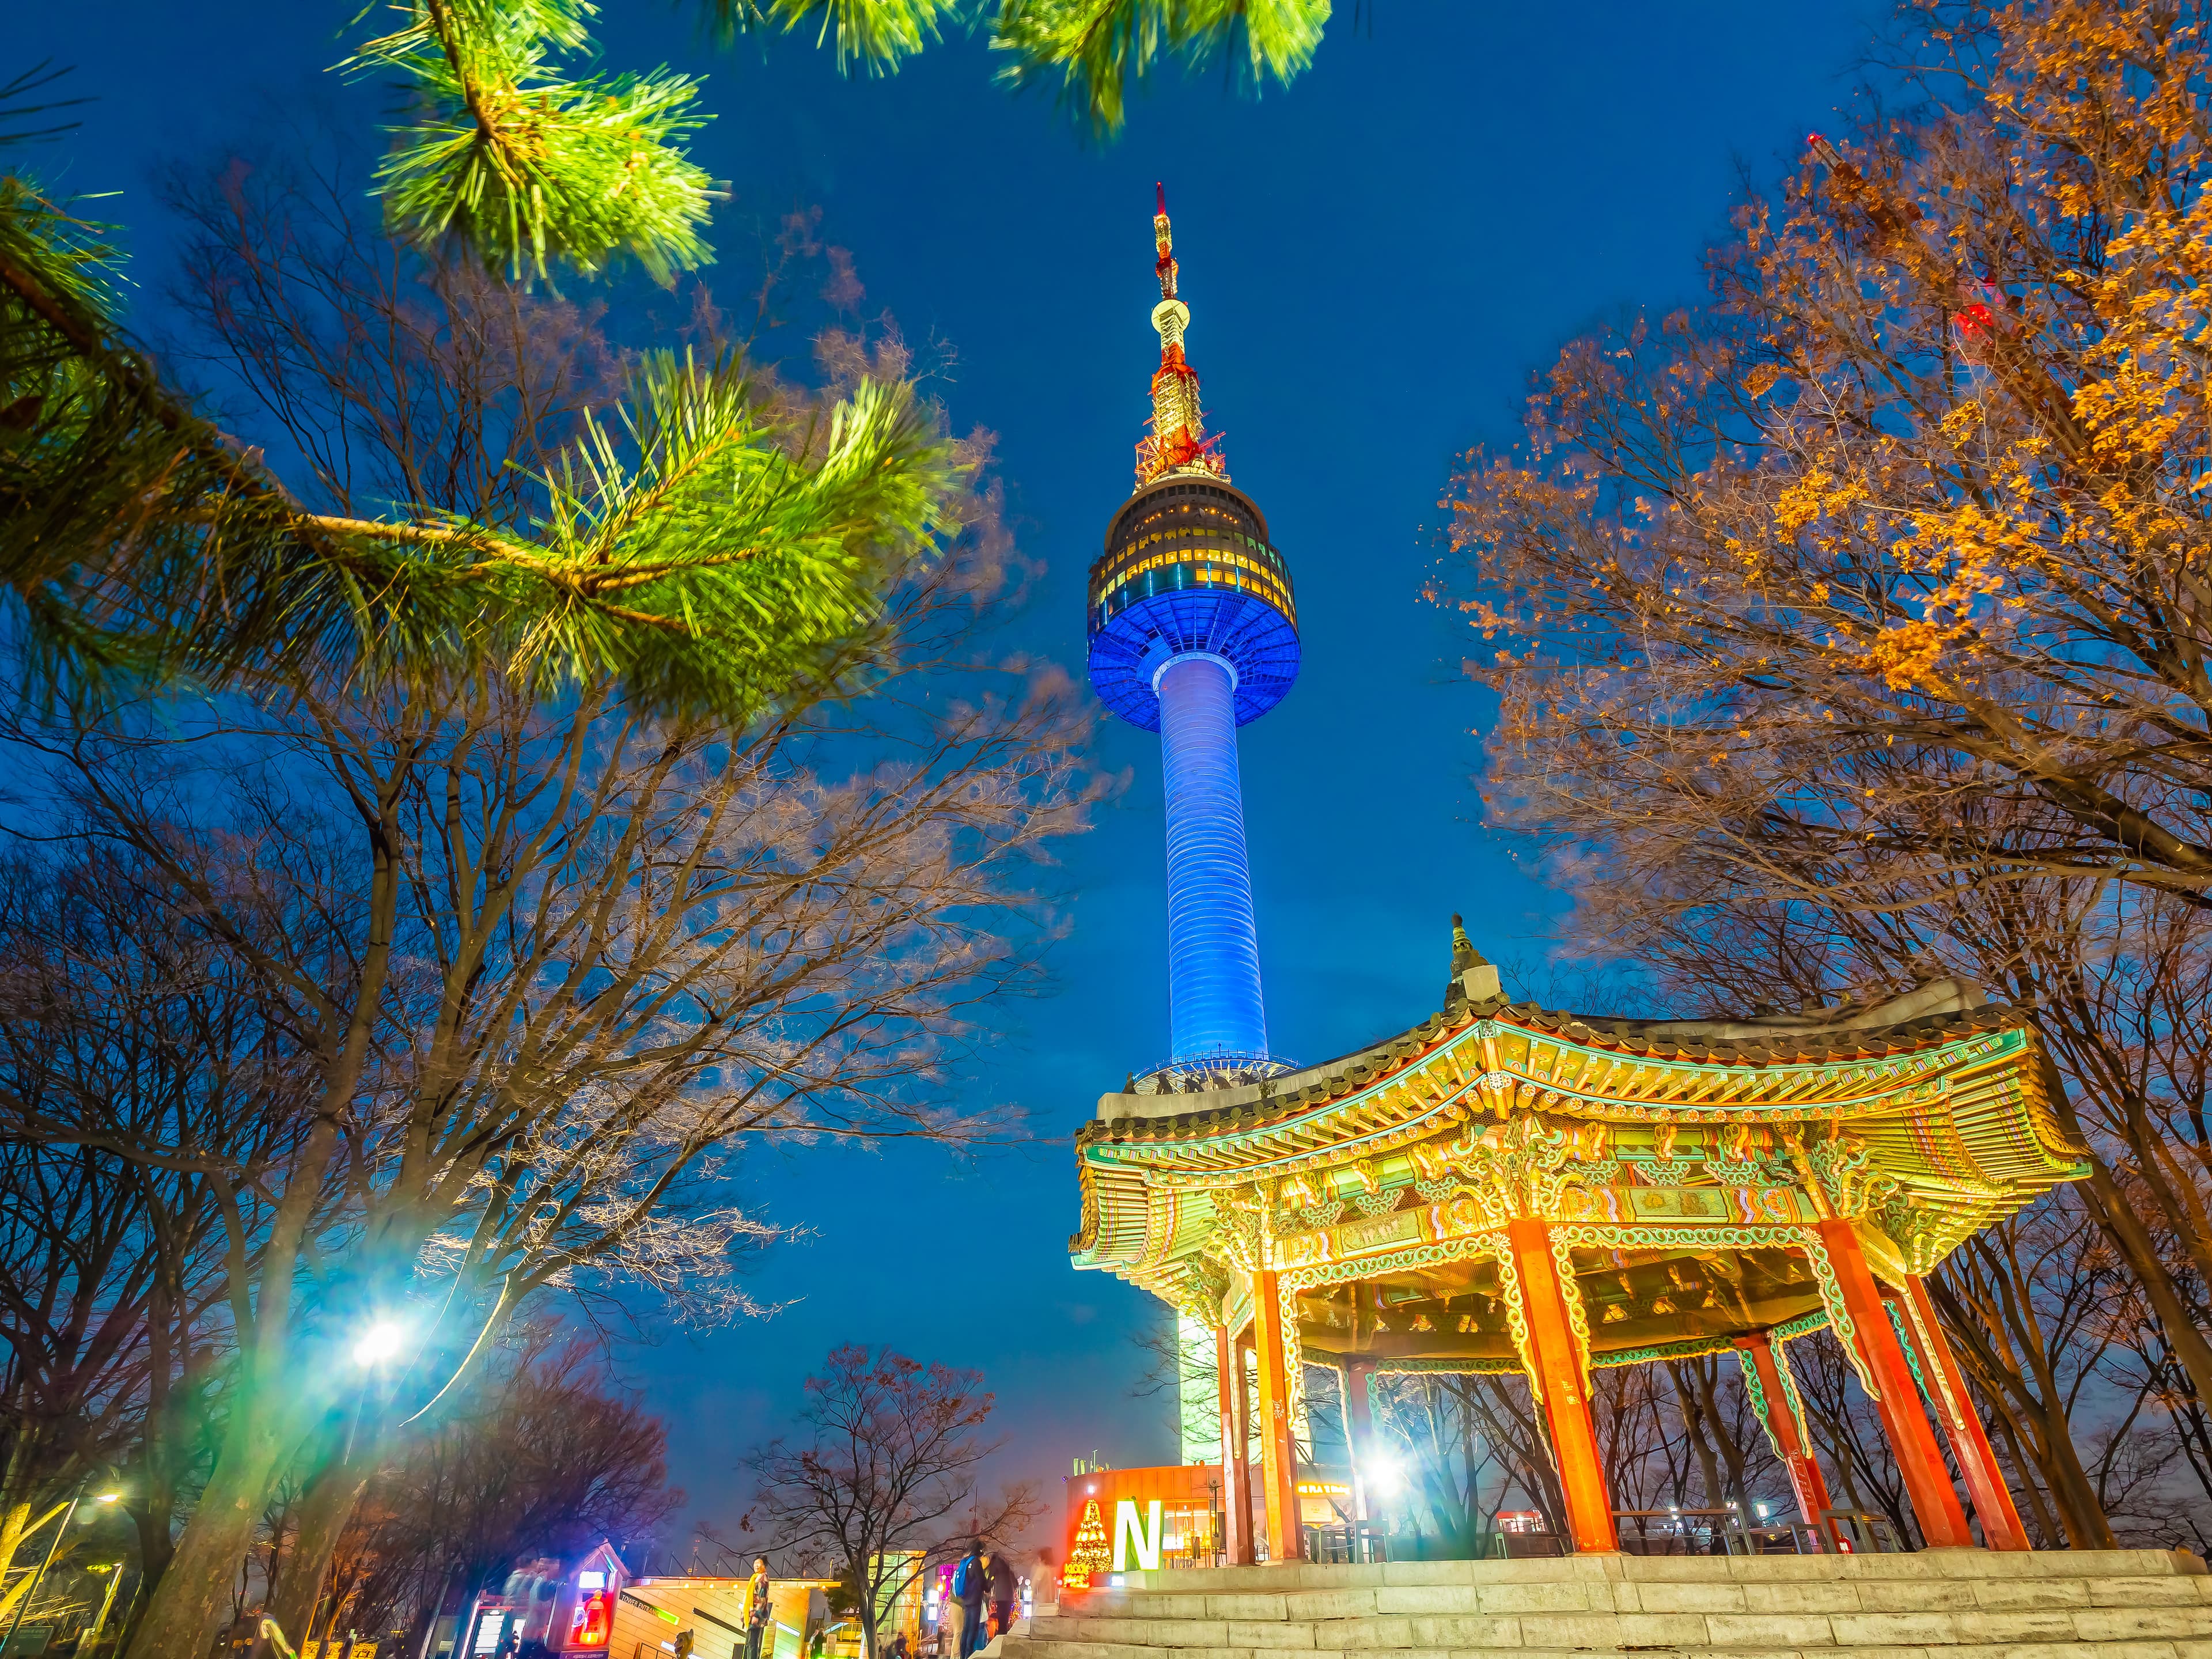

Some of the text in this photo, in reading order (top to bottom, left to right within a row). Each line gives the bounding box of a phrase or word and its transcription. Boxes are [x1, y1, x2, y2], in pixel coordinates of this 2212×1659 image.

[1113, 1499, 1162, 1572] N
[622, 1594, 660, 1618] TOWER ENTRANC
